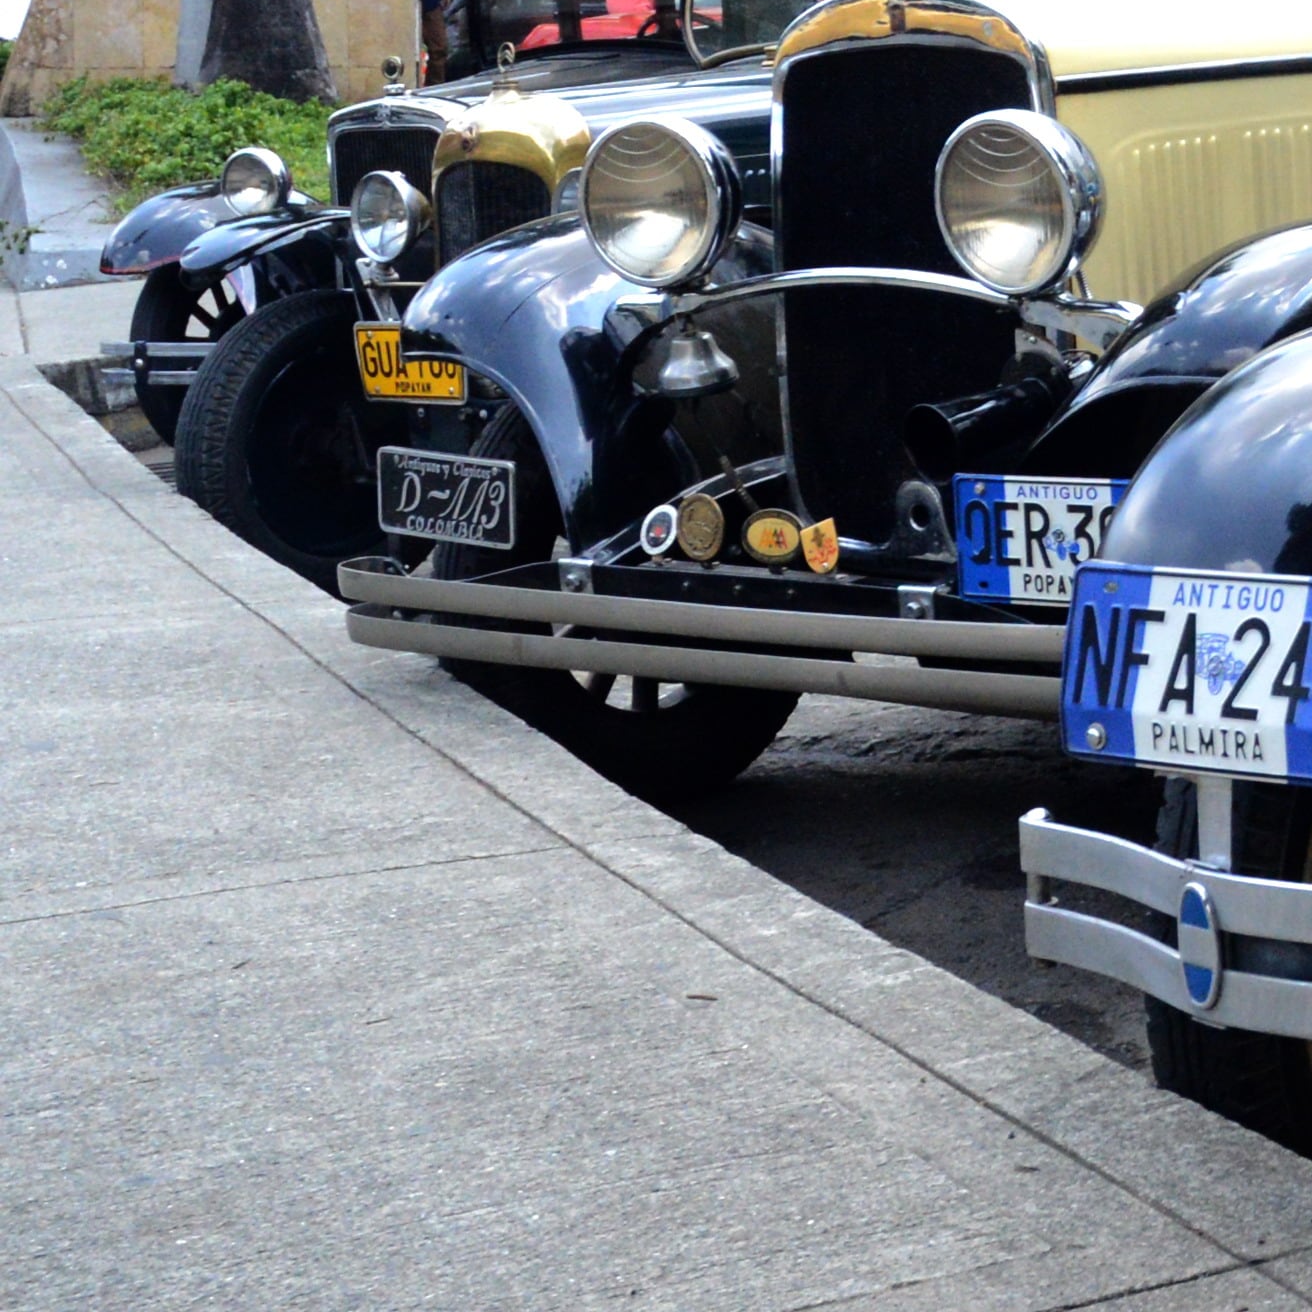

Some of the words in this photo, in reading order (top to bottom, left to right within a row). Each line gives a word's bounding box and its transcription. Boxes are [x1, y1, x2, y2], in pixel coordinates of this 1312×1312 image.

[1016, 485, 1099, 500] ANTIGUO
[406, 514, 485, 541] COLOMBIA
[1173, 581, 1285, 613] ANTIGUO
[1071, 603, 1198, 716] NFA
[1151, 723, 1265, 762] PALMIRA
